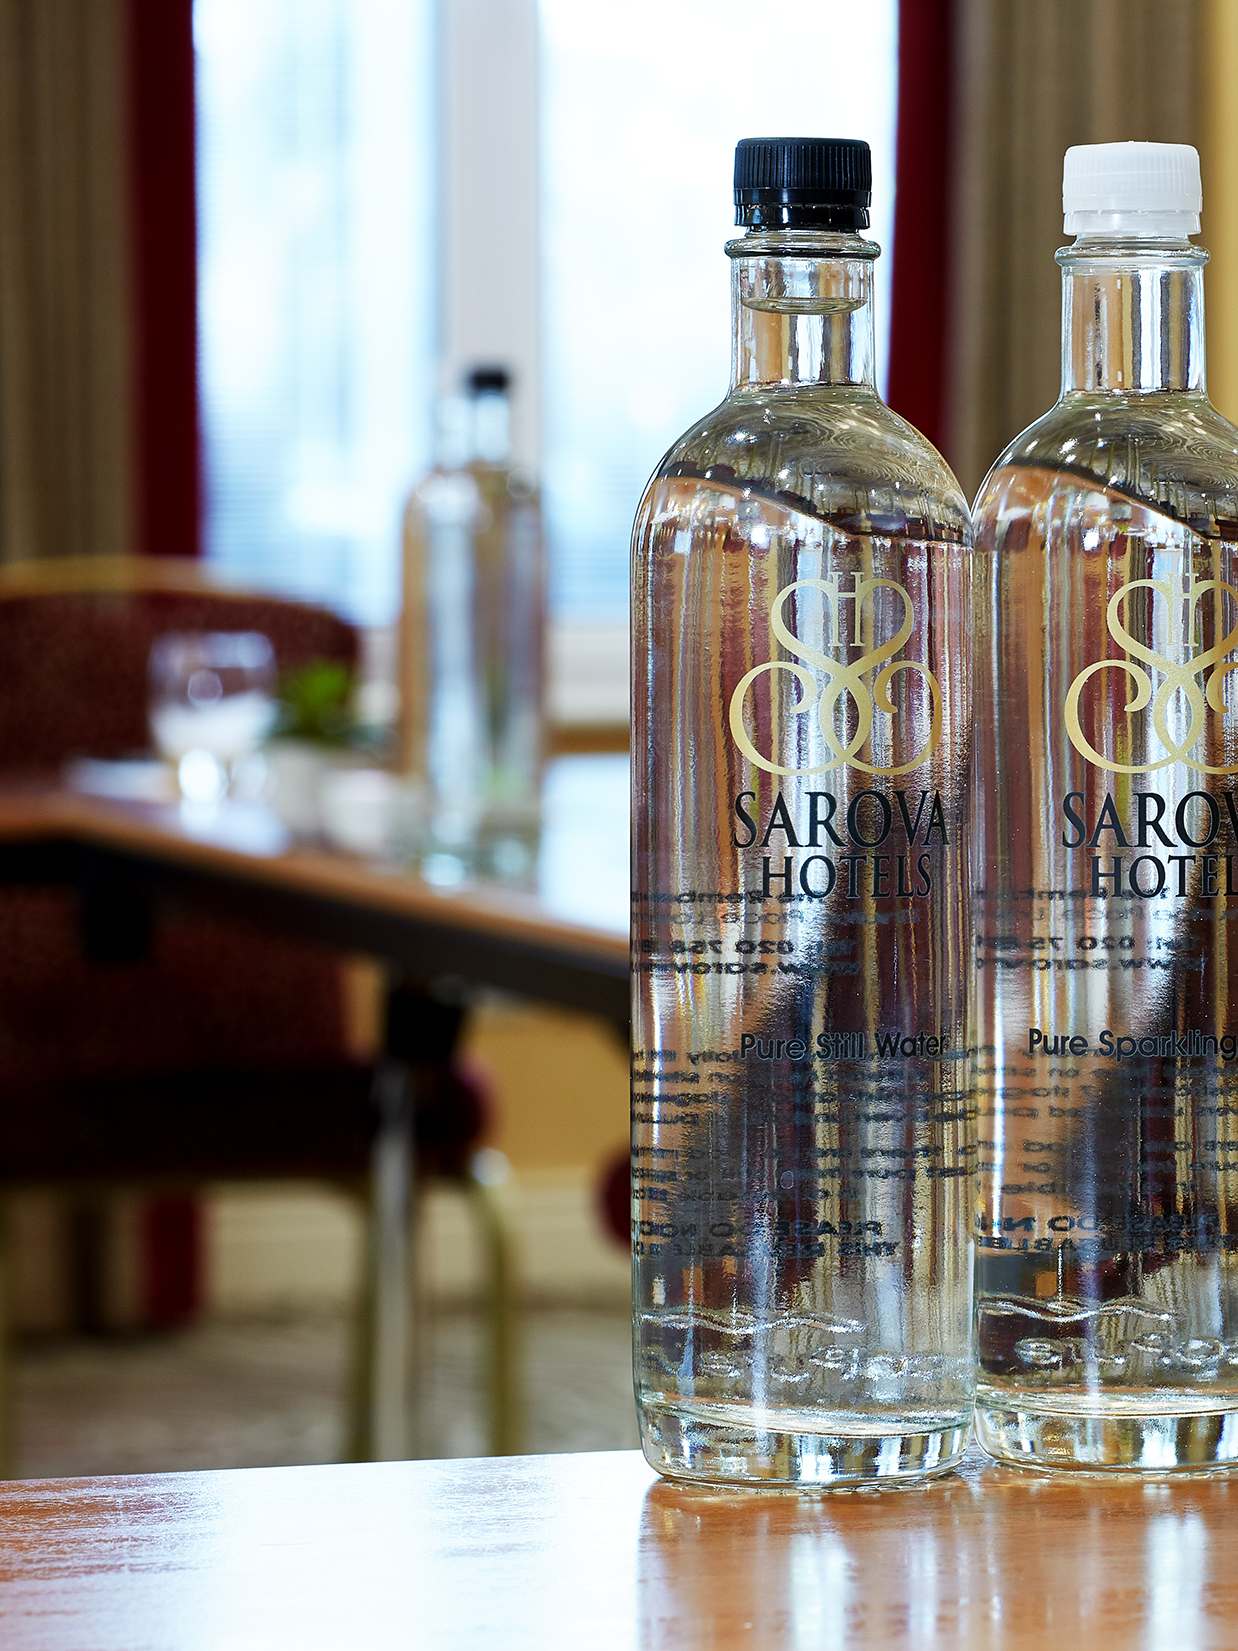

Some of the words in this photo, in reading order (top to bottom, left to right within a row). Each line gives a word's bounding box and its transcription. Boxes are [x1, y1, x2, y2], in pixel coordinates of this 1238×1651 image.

[733, 789, 950, 848] SAROVA
[760, 853, 932, 899] HOTELS
[740, 1032, 807, 1061] Pure
[815, 1031, 865, 1060] Still
[873, 1031, 946, 1058] Water
[1028, 1028, 1088, 1056] Pure
[1098, 1029, 1237, 1061] Sparkling
